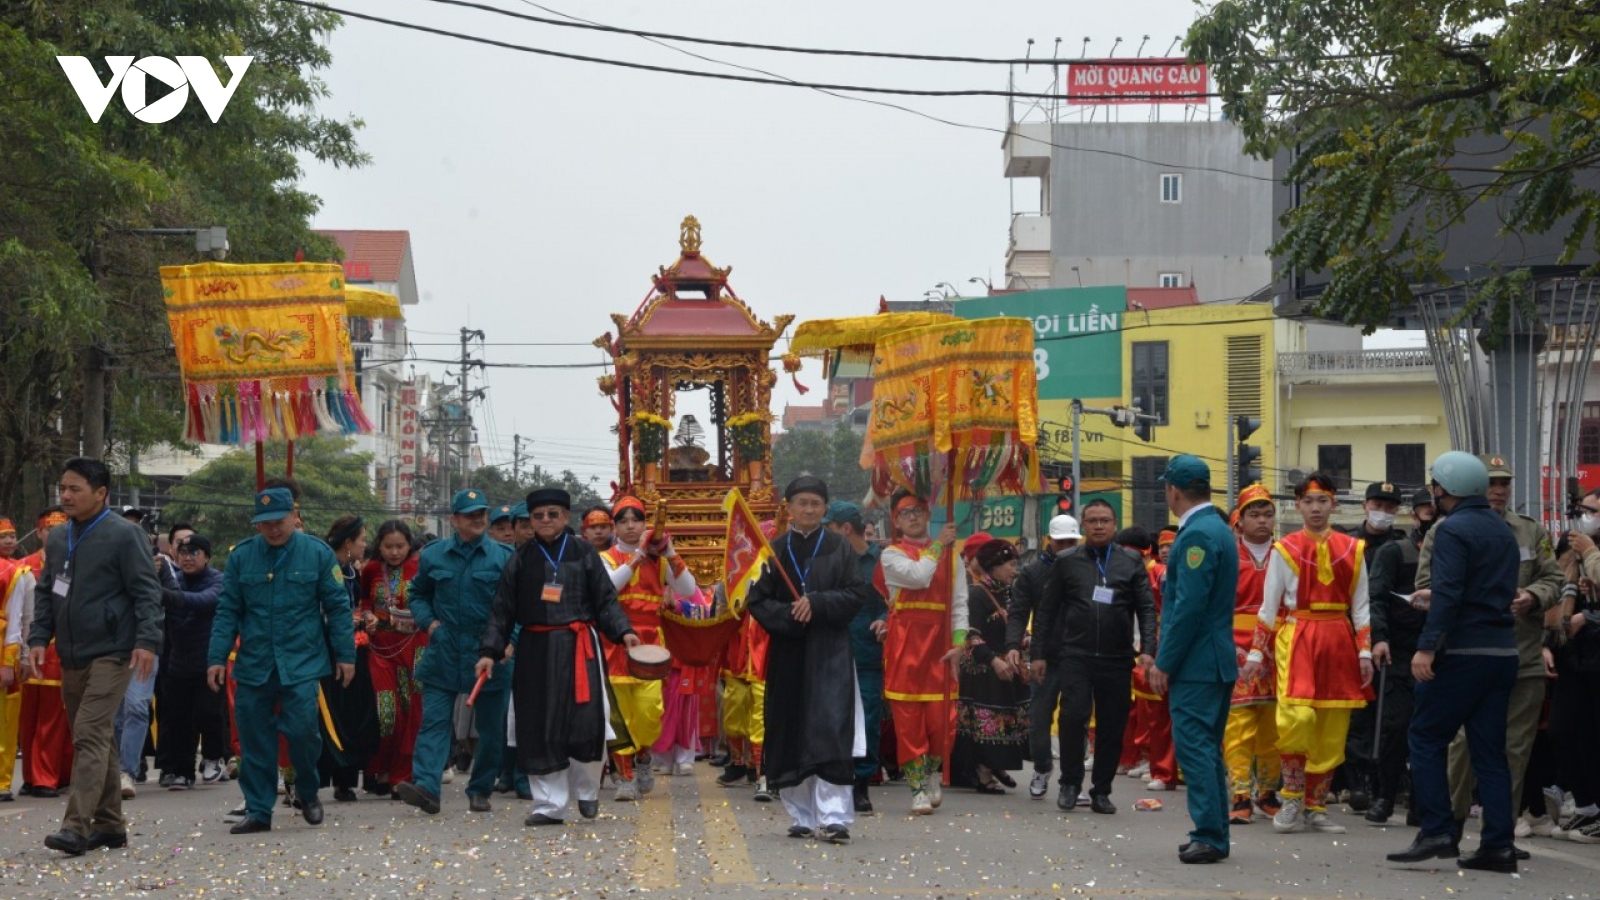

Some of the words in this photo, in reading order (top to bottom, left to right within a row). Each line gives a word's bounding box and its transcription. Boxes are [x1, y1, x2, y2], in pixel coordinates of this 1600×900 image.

[1026, 315, 1060, 339] ỌI
[1068, 303, 1117, 332] LIỀN
[1055, 430, 1105, 443] f8.vn
